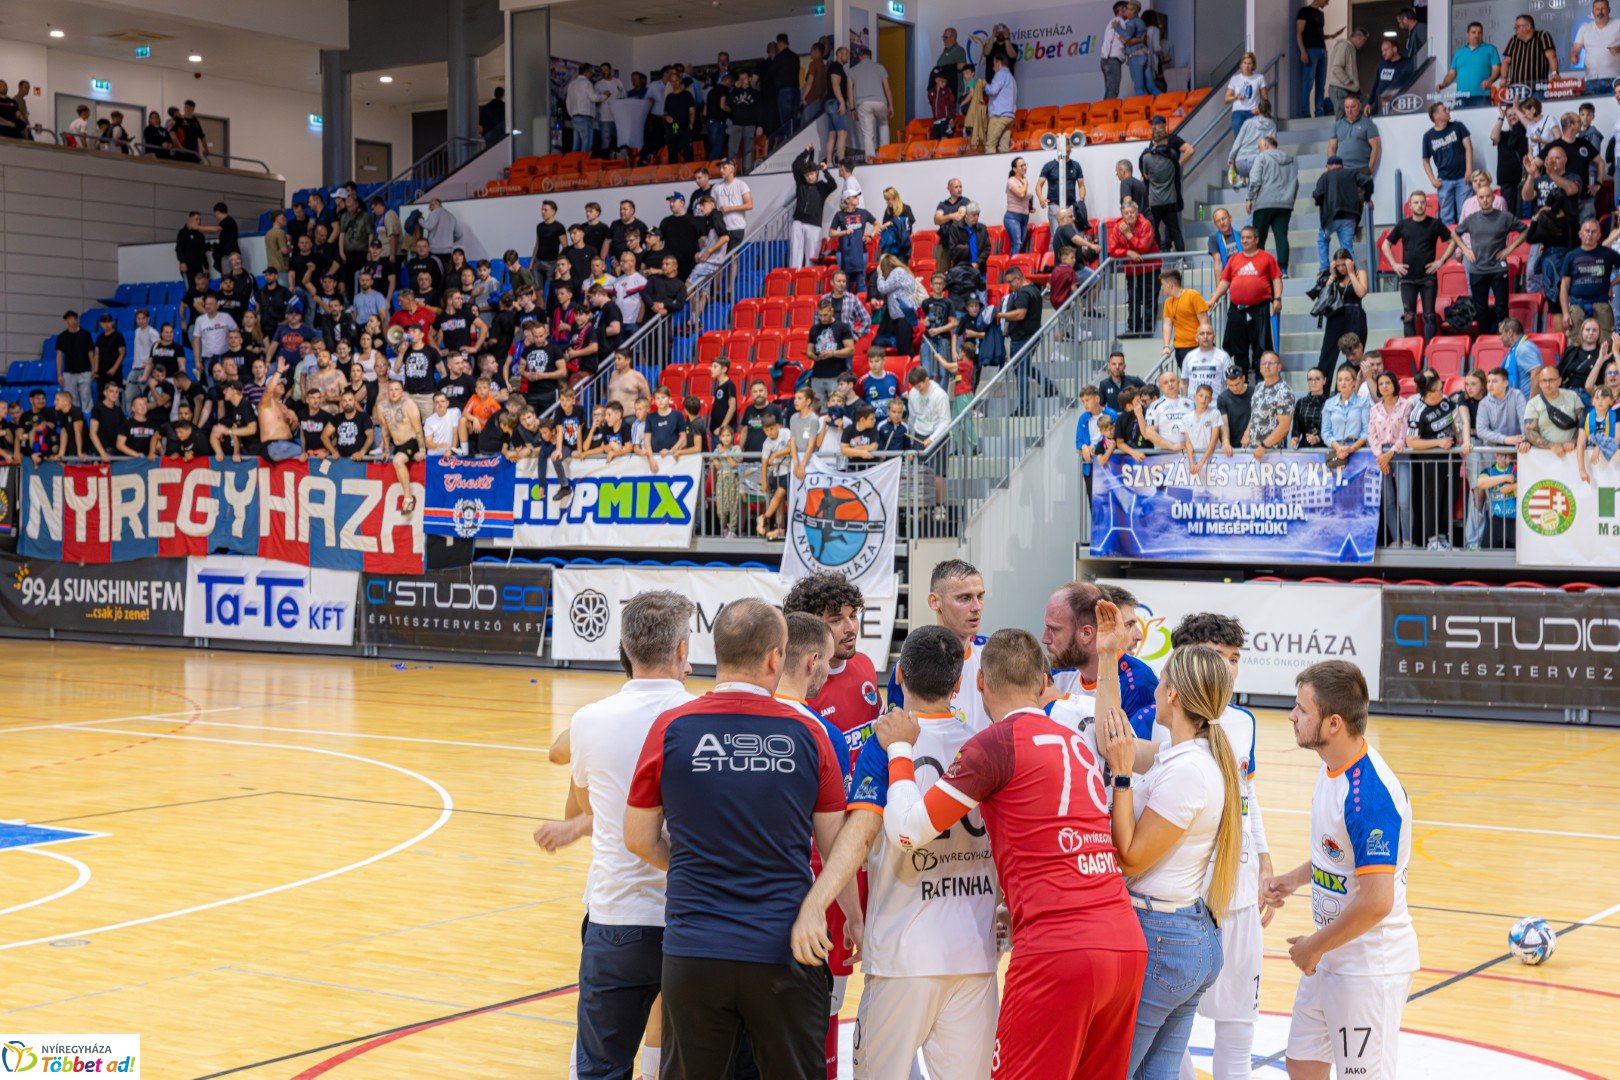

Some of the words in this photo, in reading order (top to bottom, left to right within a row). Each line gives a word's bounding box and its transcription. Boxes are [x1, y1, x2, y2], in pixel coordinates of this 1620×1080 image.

[1017, 41, 1064, 62] bbet
[1067, 35, 1097, 56] ad!
[444, 473, 495, 492] Guests
[1206, 457, 1231, 487] ÉS
[1235, 460, 1299, 487] TÁRSA
[26, 459, 425, 554] NYÍREGYHÁZA
[1171, 500, 1194, 519] ÖN
[1187, 521, 1203, 534] MI
[21, 577, 62, 606] 99.4
[63, 578, 150, 606] SUNSHINE
[150, 581, 184, 611] FM
[197, 569, 306, 629] Ta-Te
[309, 603, 346, 631] KFT
[501, 585, 546, 612] 90
[113, 605, 123, 622] jó
[124, 608, 150, 621] zene!
[513, 622, 543, 633] KFT
[1240, 628, 1357, 656] EGYHÁZA
[1241, 655, 1271, 667] VÁROS
[1273, 656, 1319, 668] ÖNKORM
[692, 733, 795, 757] A'90
[692, 756, 796, 773] STUDIO
[1032, 734, 1110, 817] 78
[921, 874, 994, 901] RAFINHA
[1339, 1026, 1372, 1058] 17
[1343, 1066, 1367, 1075] JAKO
